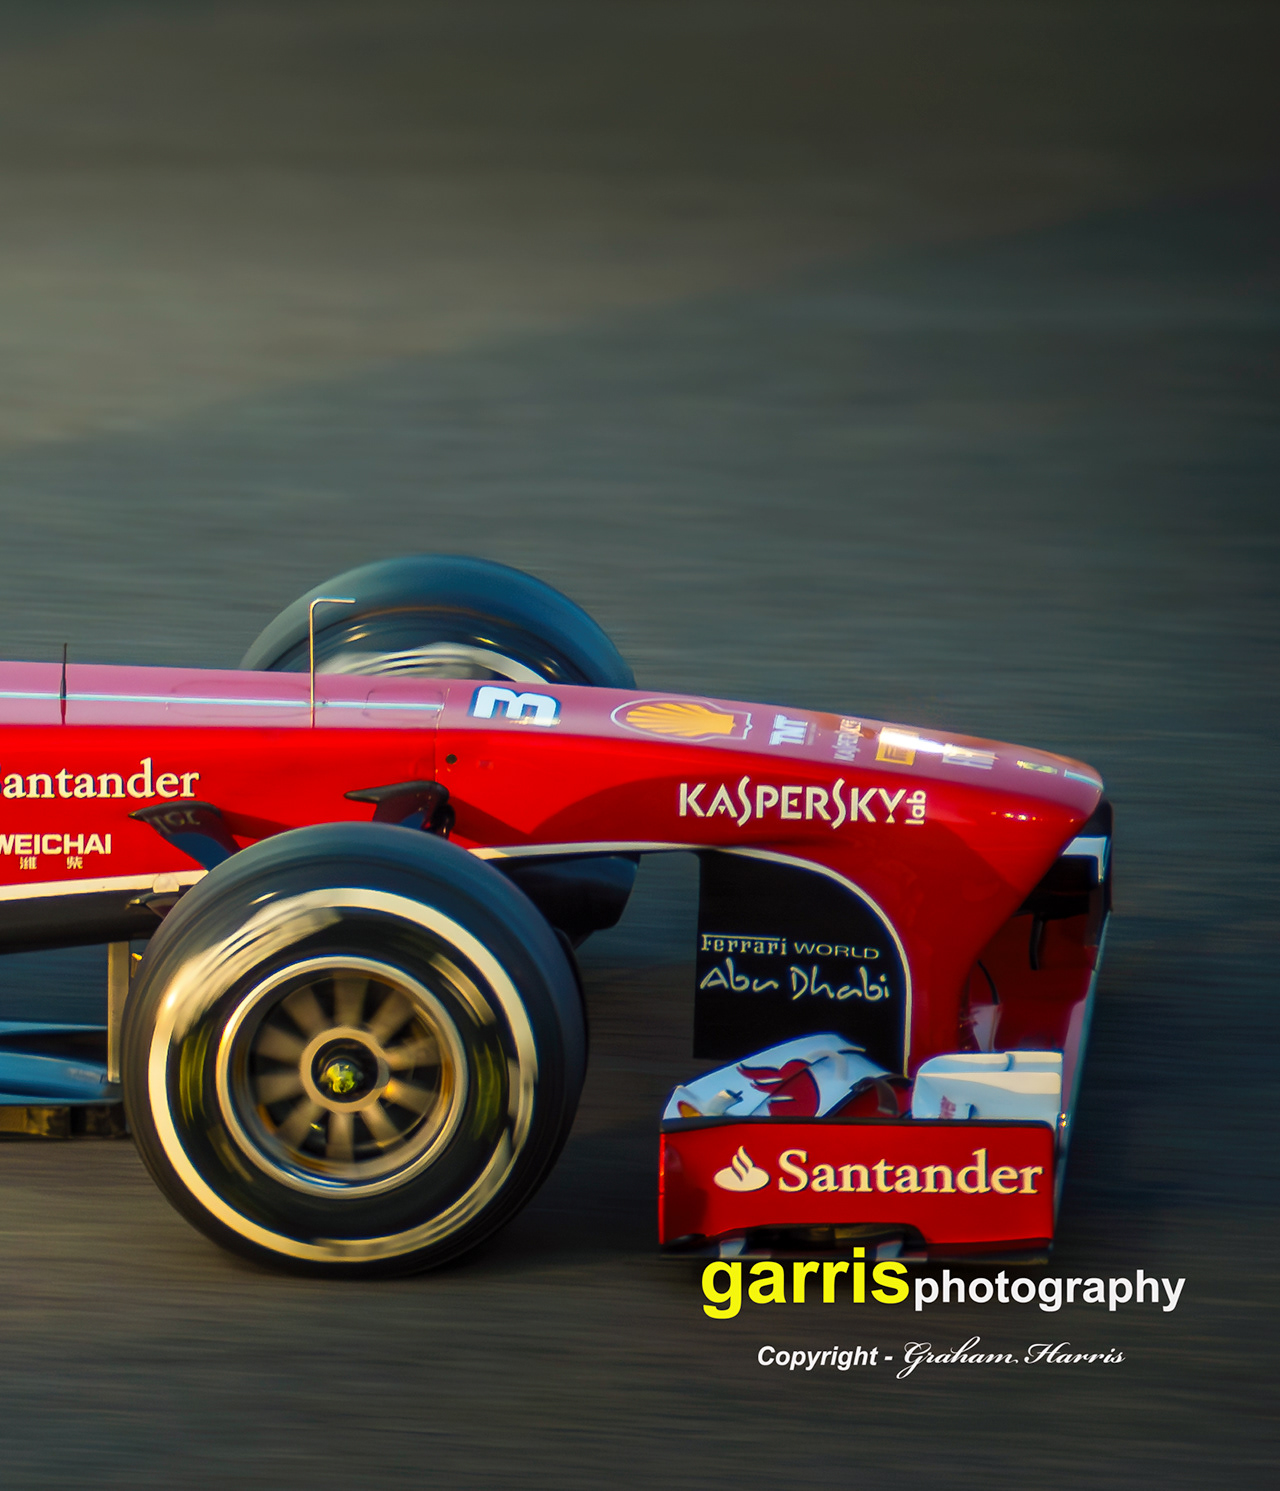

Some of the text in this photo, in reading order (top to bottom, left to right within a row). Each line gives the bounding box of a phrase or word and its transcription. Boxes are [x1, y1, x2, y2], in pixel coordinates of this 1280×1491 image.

[469, 685, 560, 727] 3
[679, 775, 907, 829] KASPERSKY
[701, 934, 880, 960] Ferrari WORLD
[700, 957, 890, 1001] Abu Dhabi
[778, 1149, 1045, 1195] Santander
